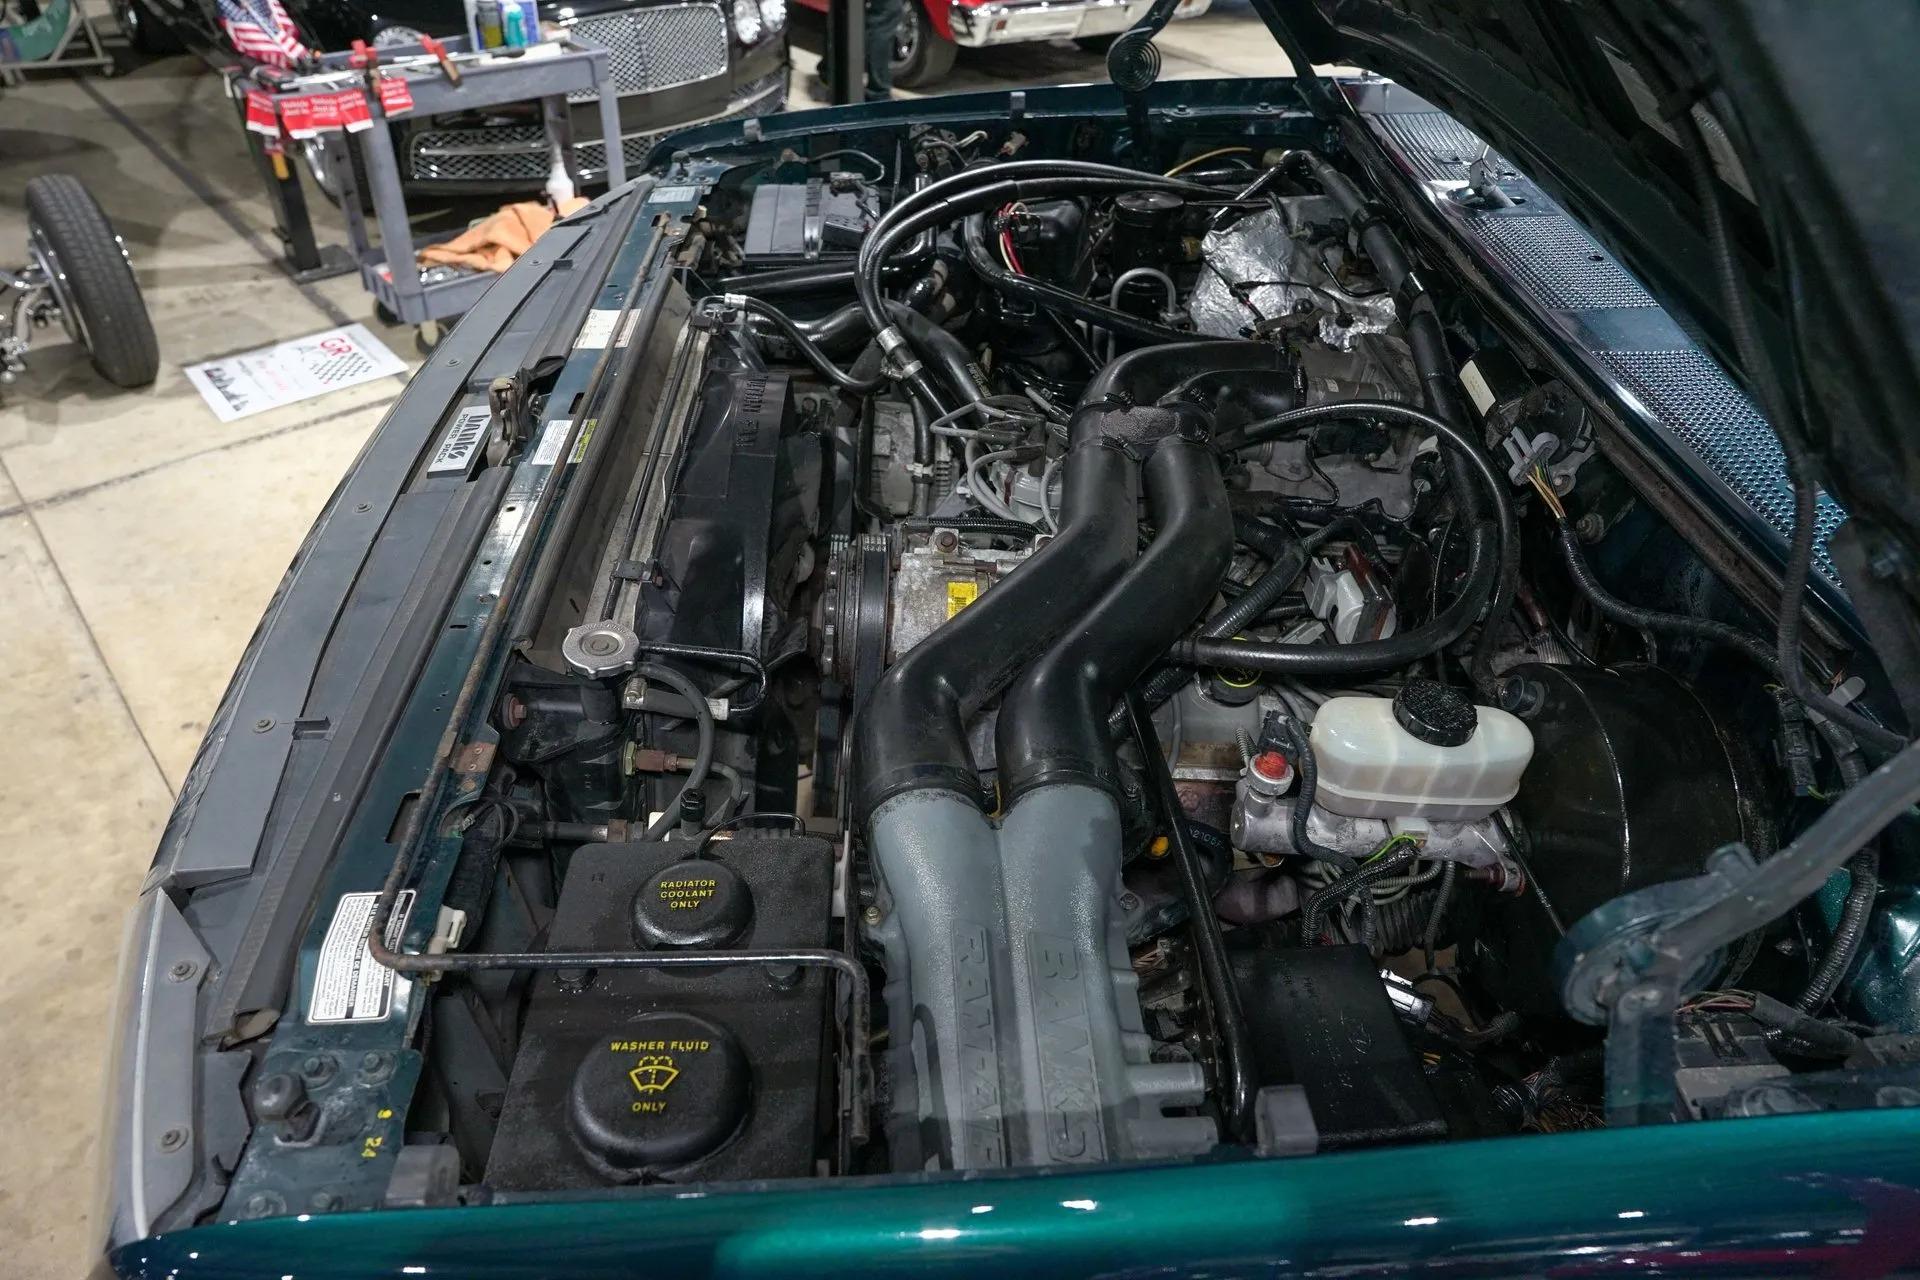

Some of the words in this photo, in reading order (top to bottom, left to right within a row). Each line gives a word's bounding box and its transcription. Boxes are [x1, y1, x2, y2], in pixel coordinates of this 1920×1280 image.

[449, 413, 469, 442] POWER
[433, 443, 456, 464] PACK
[660, 880, 716, 888] RADIATOR
[660, 889, 715, 898] COOLANT
[670, 900, 700, 908] ONLY
[611, 1041, 665, 1051] WASHER
[671, 1041, 709, 1050] FLUID
[632, 1102, 667, 1112] ONLY
